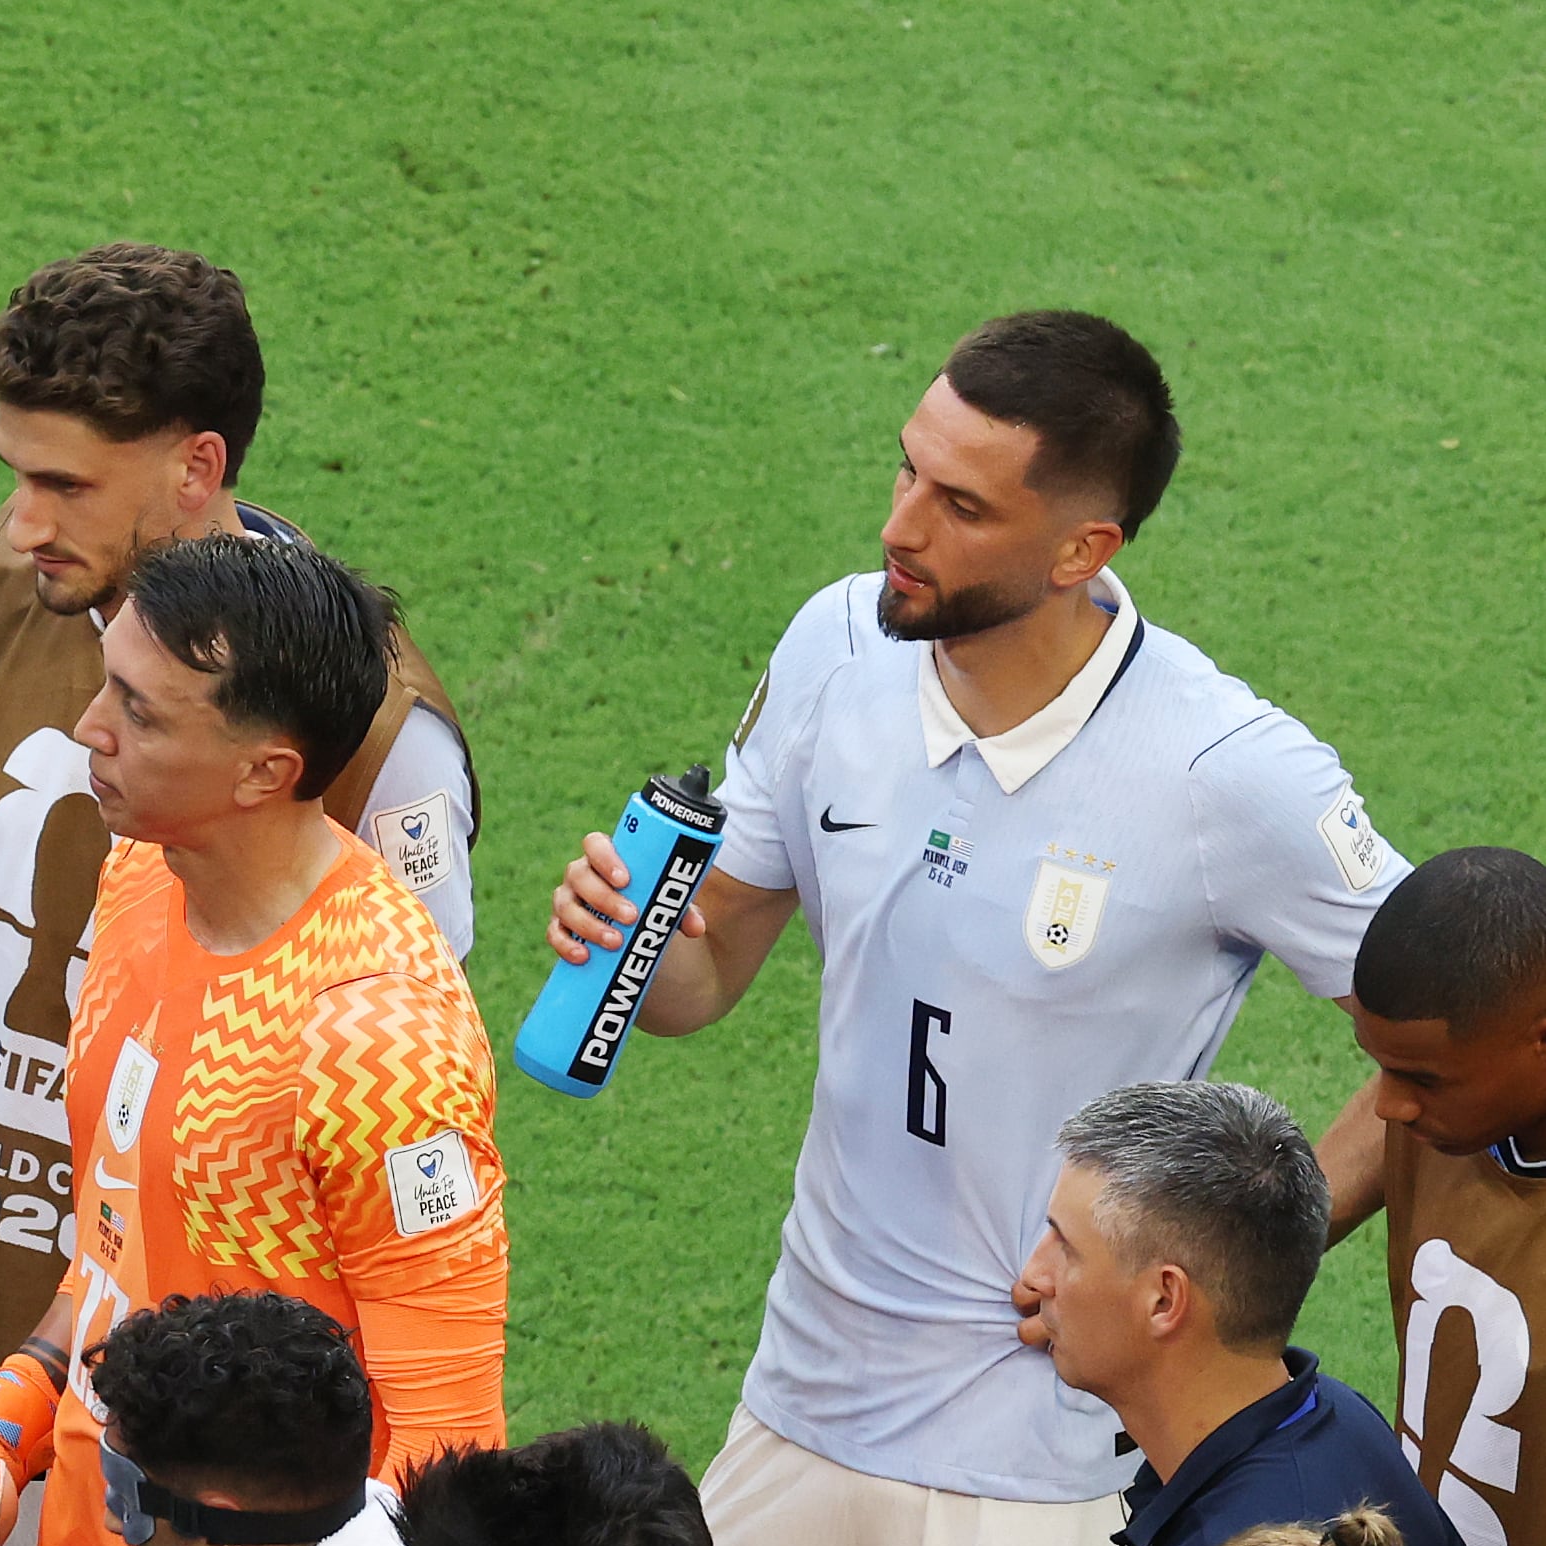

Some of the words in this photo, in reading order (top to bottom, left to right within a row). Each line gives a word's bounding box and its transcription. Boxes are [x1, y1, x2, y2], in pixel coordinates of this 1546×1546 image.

[650, 790, 715, 828] POWERADE
[623, 813, 639, 834] 18
[404, 851, 439, 876] PEACE
[414, 872, 434, 884] FIFA
[580, 855, 703, 1069] POWERADE
[906, 998, 951, 1147] 6
[414, 1183, 441, 1200] Unite
[419, 1191, 458, 1216] PEACE
[430, 1213, 451, 1224] FIFA
